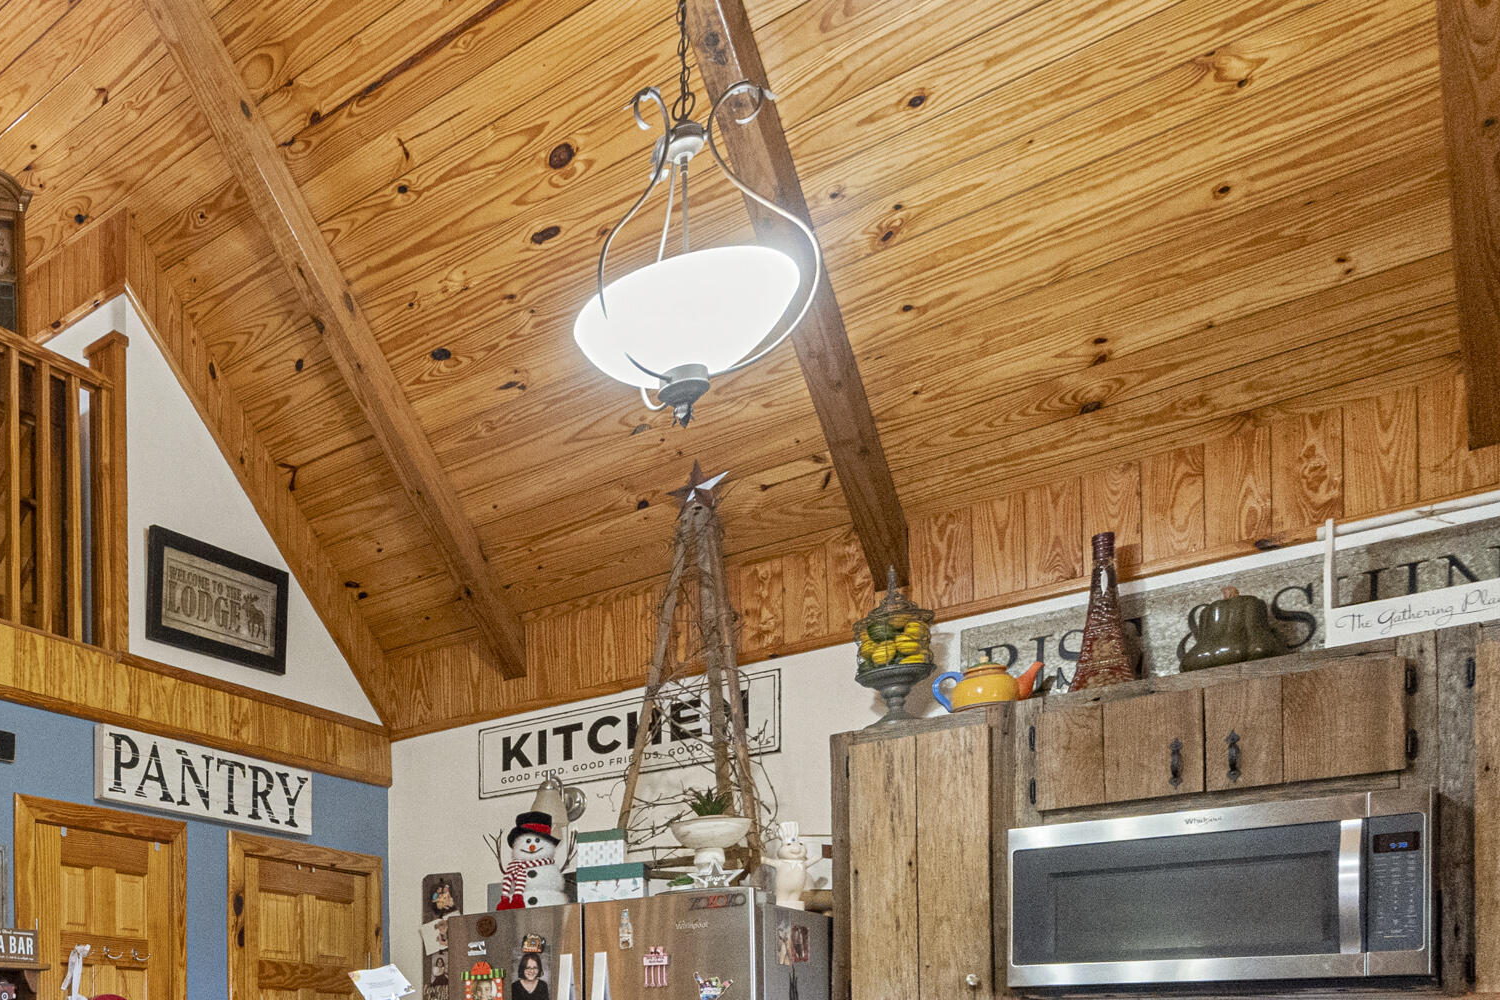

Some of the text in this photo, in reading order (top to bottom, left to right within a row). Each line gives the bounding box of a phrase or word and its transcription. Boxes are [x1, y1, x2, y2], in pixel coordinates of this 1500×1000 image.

[169, 565, 242, 601] WELCOME TO THE
[167, 580, 242, 632] LODGE
[1377, 604, 1454, 635] Gathering
[108, 732, 309, 828] PANTRY
[501, 774, 530, 784] GOOD
[573, 760, 604, 772] GOOD
[9, 935, 34, 955] BAR
